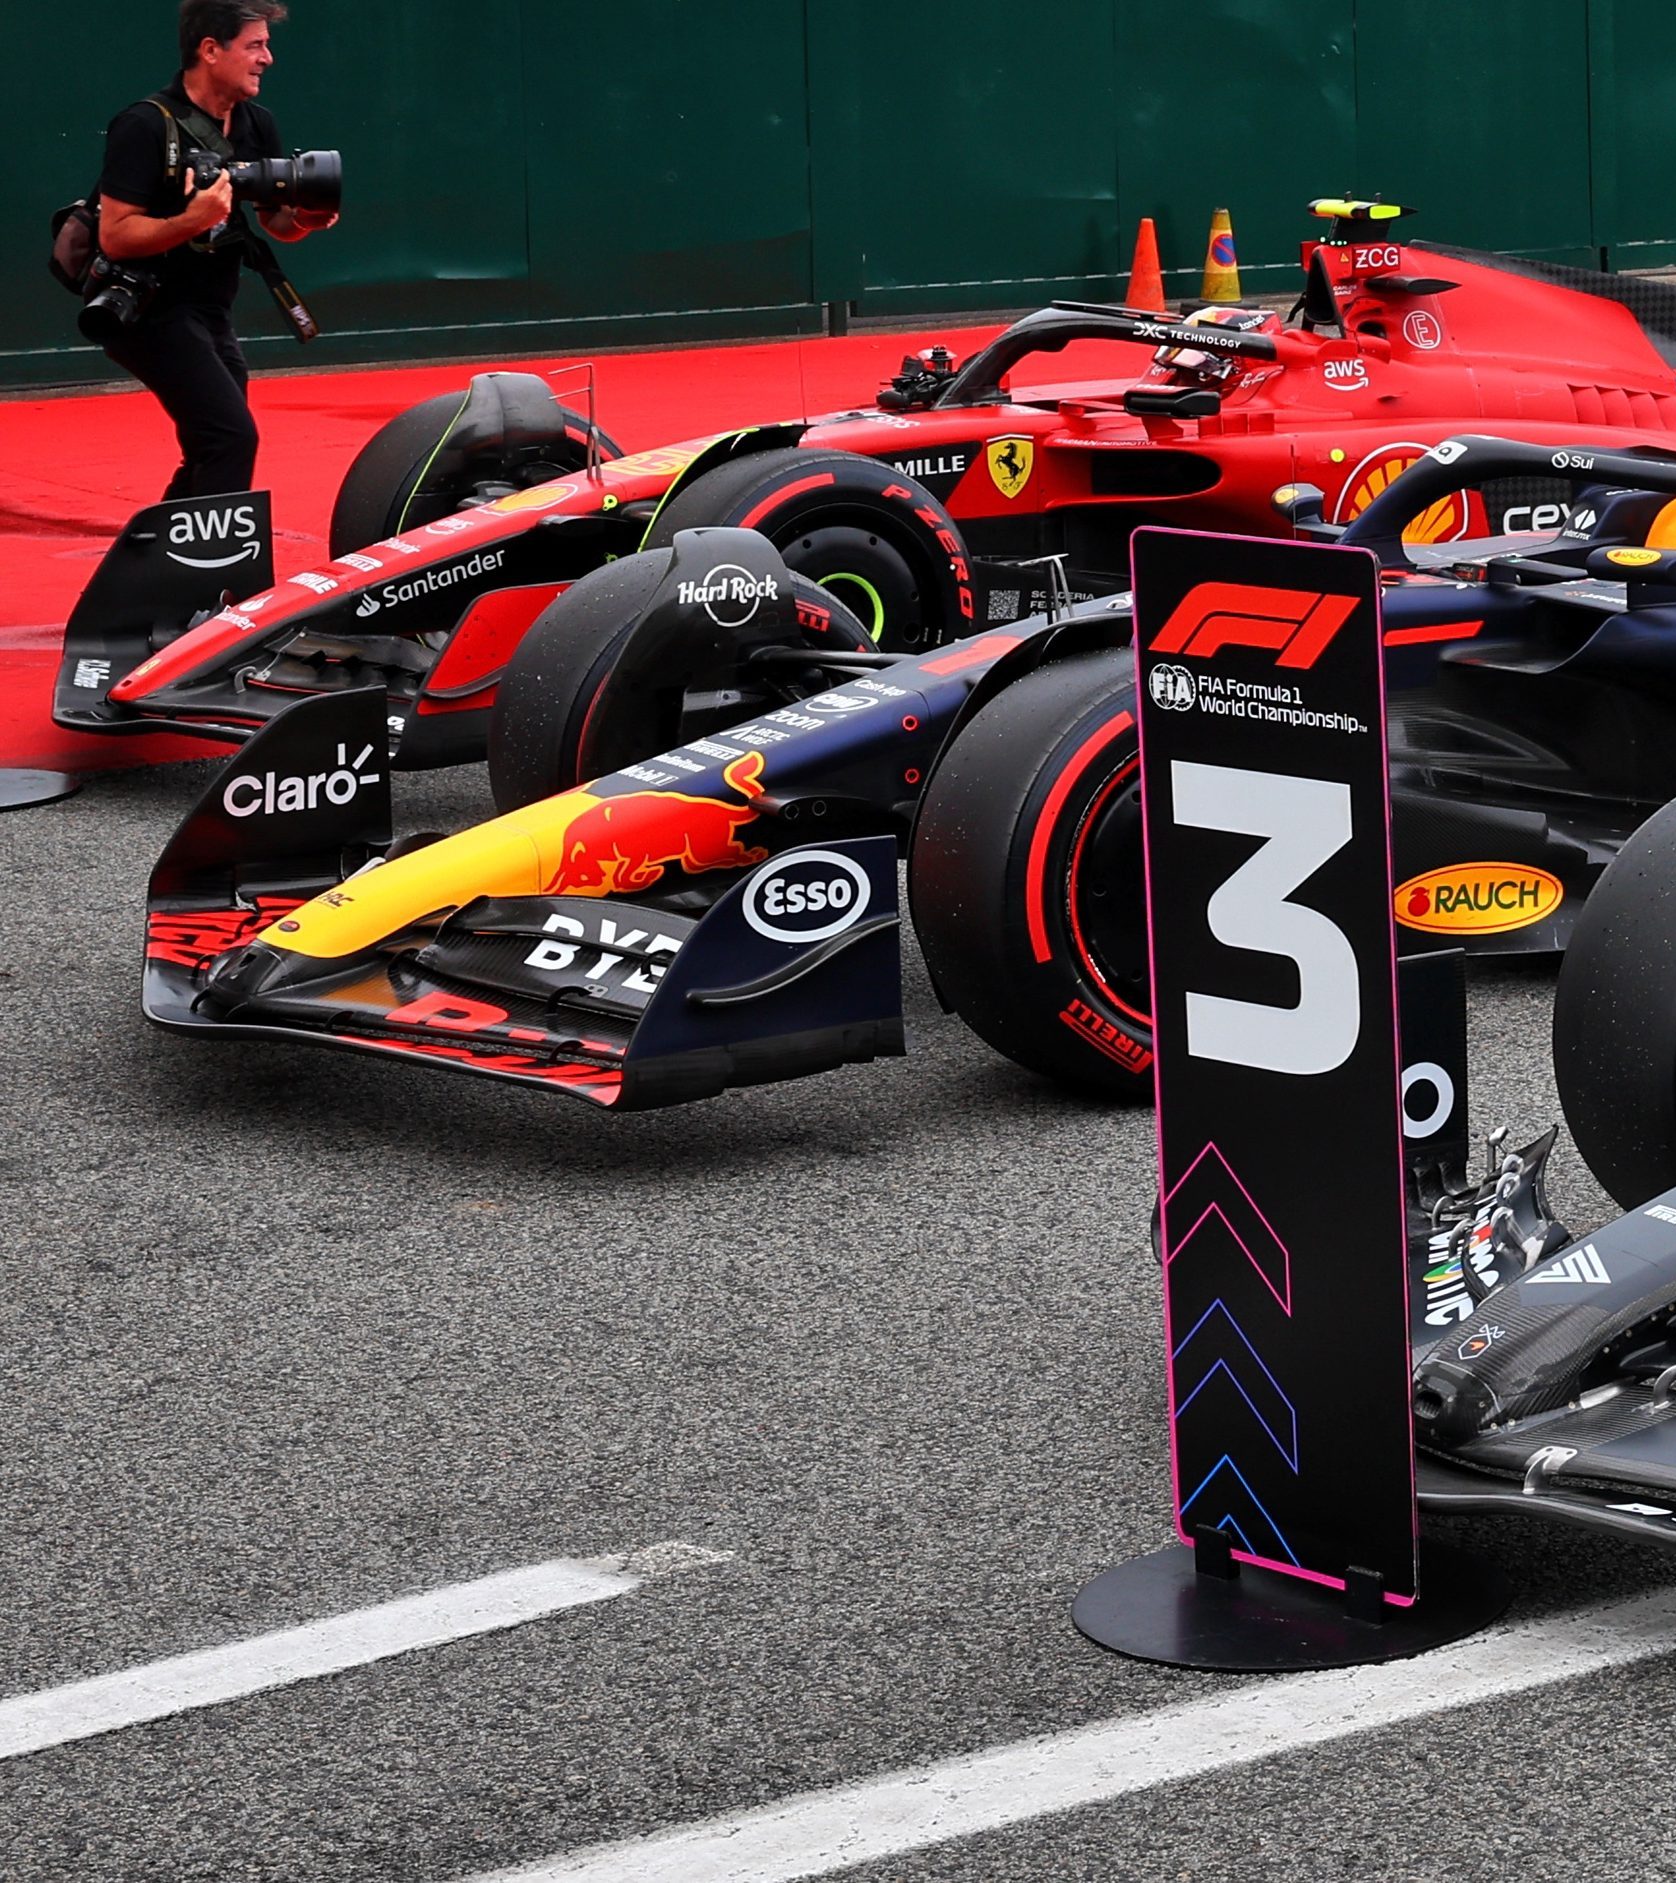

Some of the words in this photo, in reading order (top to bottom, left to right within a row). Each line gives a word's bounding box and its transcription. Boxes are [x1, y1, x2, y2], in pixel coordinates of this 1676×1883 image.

[1355, 246, 1399, 269] ZCG
[1170, 330, 1241, 349] TECHNOLOGY
[1324, 358, 1366, 378] aws
[895, 454, 966, 477] MILLE
[1570, 455, 1594, 470] Sui
[882, 484, 912, 500] P
[168, 506, 257, 543] aws
[383, 550, 506, 608] Santander
[677, 582, 726, 604] Hard
[731, 574, 778, 603] Rock
[1199, 676, 1225, 695] FIA
[1227, 678, 1291, 702] Formula
[1293, 687, 1303, 705] 1
[1200, 696, 1246, 718] World
[1248, 700, 1358, 734] Championship
[223, 767, 359, 818] Claro
[1434, 880, 1540, 914] RAUCH
[1171, 760, 1361, 1075] 3
